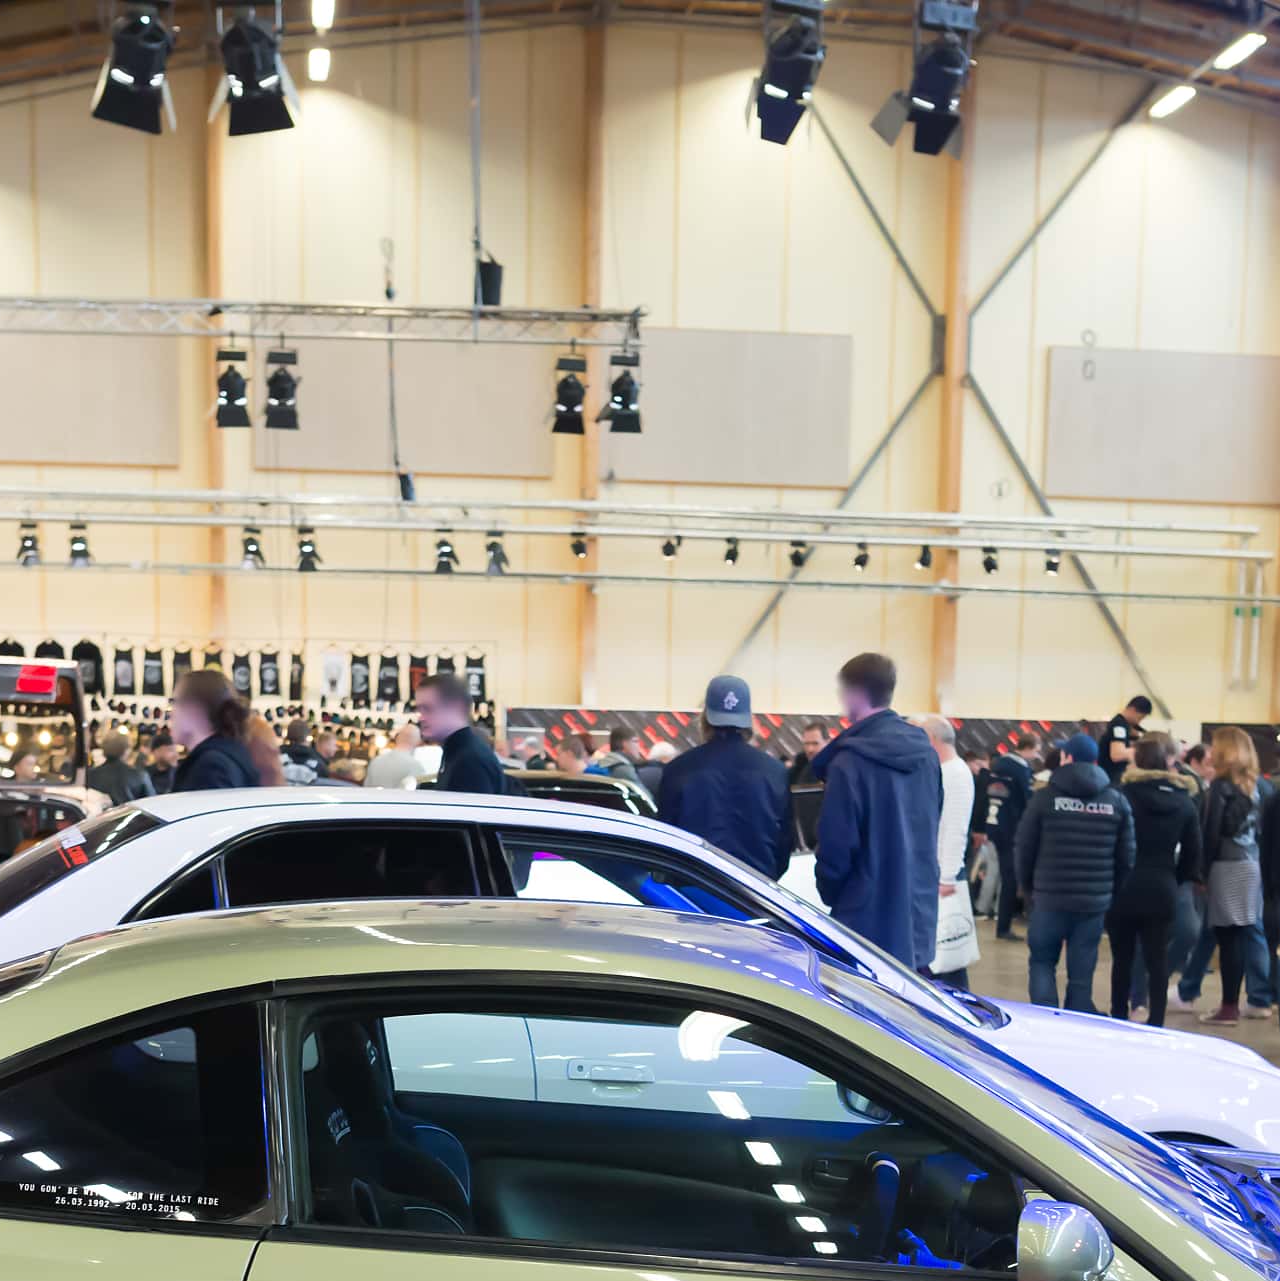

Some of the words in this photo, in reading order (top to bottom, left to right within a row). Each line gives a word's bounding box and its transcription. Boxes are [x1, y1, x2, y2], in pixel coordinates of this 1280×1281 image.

[19, 1183, 35, 1192] YOU
[67, 1187, 78, 1195] BE
[149, 1193, 165, 1202] THE
[170, 1194, 192, 1204] LAST
[197, 1196, 219, 1206] RIDE
[55, 1196, 110, 1208] 26.03.1992
[125, 1202, 180, 1213] 20.03.2015
